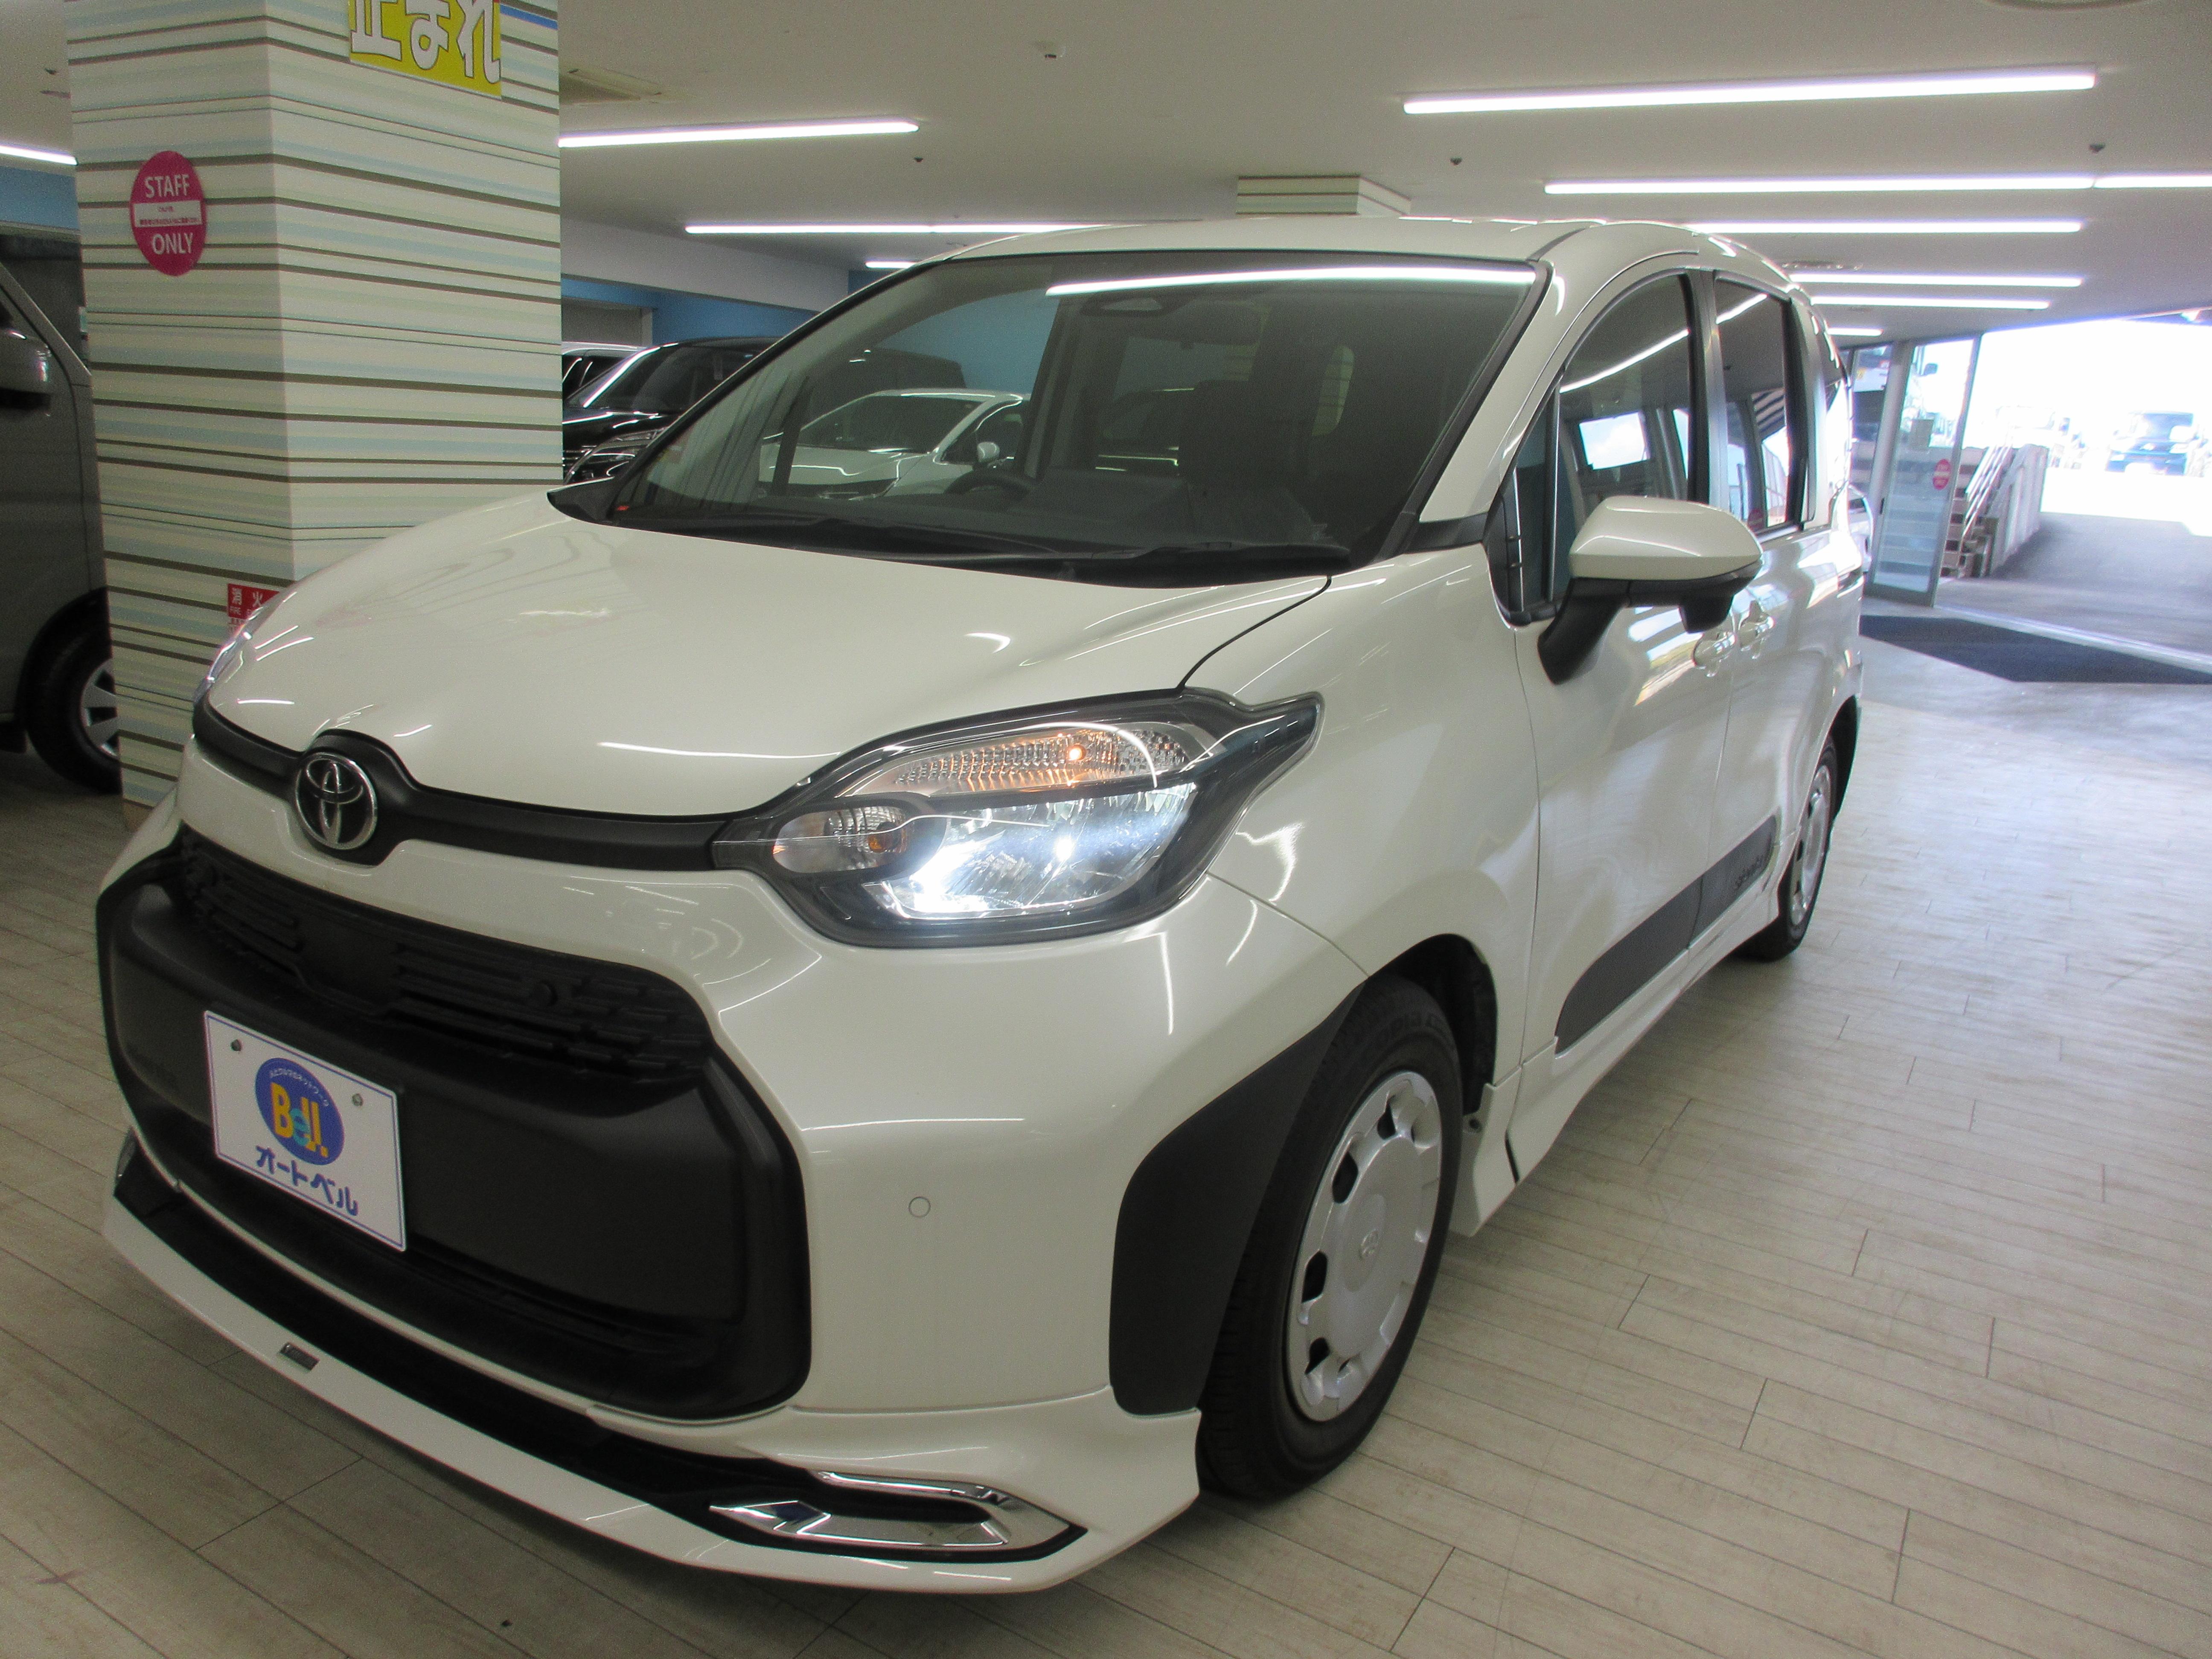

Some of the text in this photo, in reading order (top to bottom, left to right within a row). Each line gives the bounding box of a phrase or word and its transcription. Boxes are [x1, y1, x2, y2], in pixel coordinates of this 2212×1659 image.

[144, 173, 190, 198] STAFF
[152, 233, 193, 255] ONLY
[256, 1145, 358, 1216] オートベル
